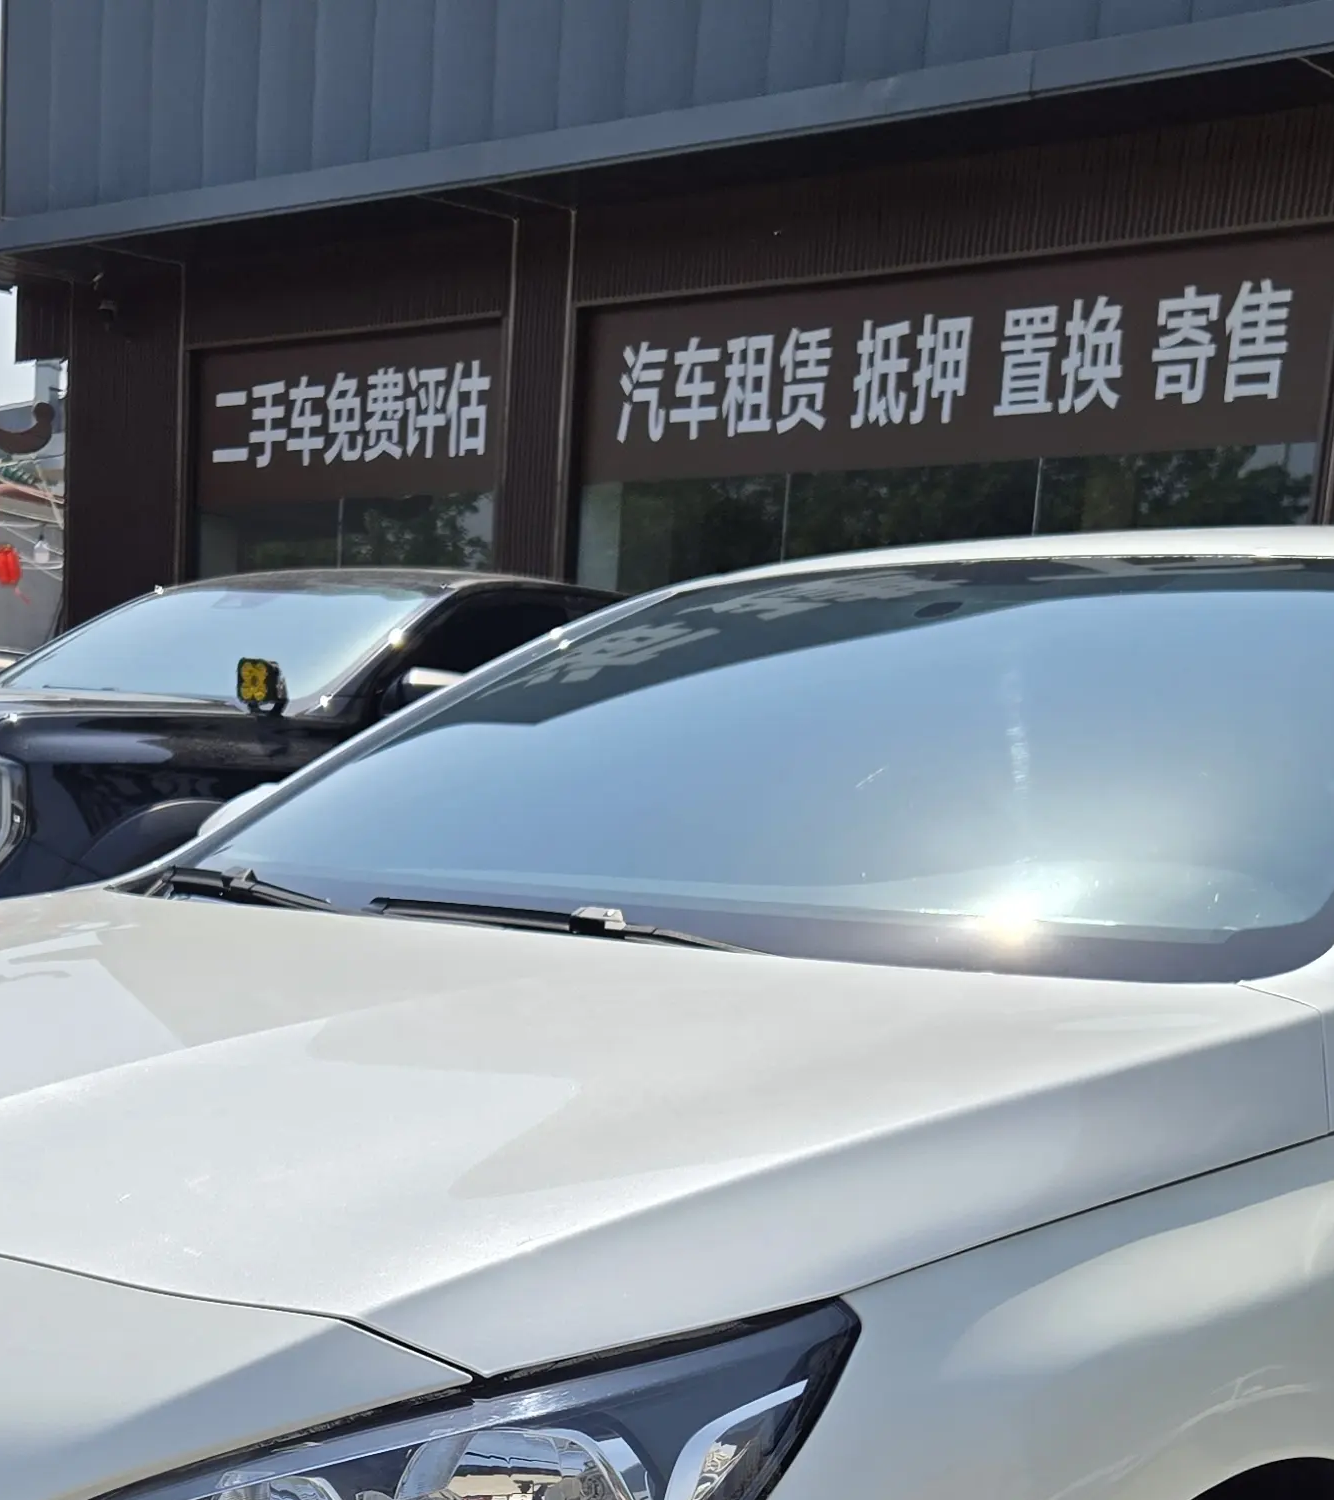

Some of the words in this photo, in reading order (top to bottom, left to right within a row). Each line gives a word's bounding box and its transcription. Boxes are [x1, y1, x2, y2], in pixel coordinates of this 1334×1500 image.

[212, 359, 491, 468] 二手车免费评估
[617, 327, 833, 443] 汽车租赁
[849, 314, 973, 429] 抵押
[994, 296, 1123, 417] 置换
[1151, 279, 1293, 404] 寄售
